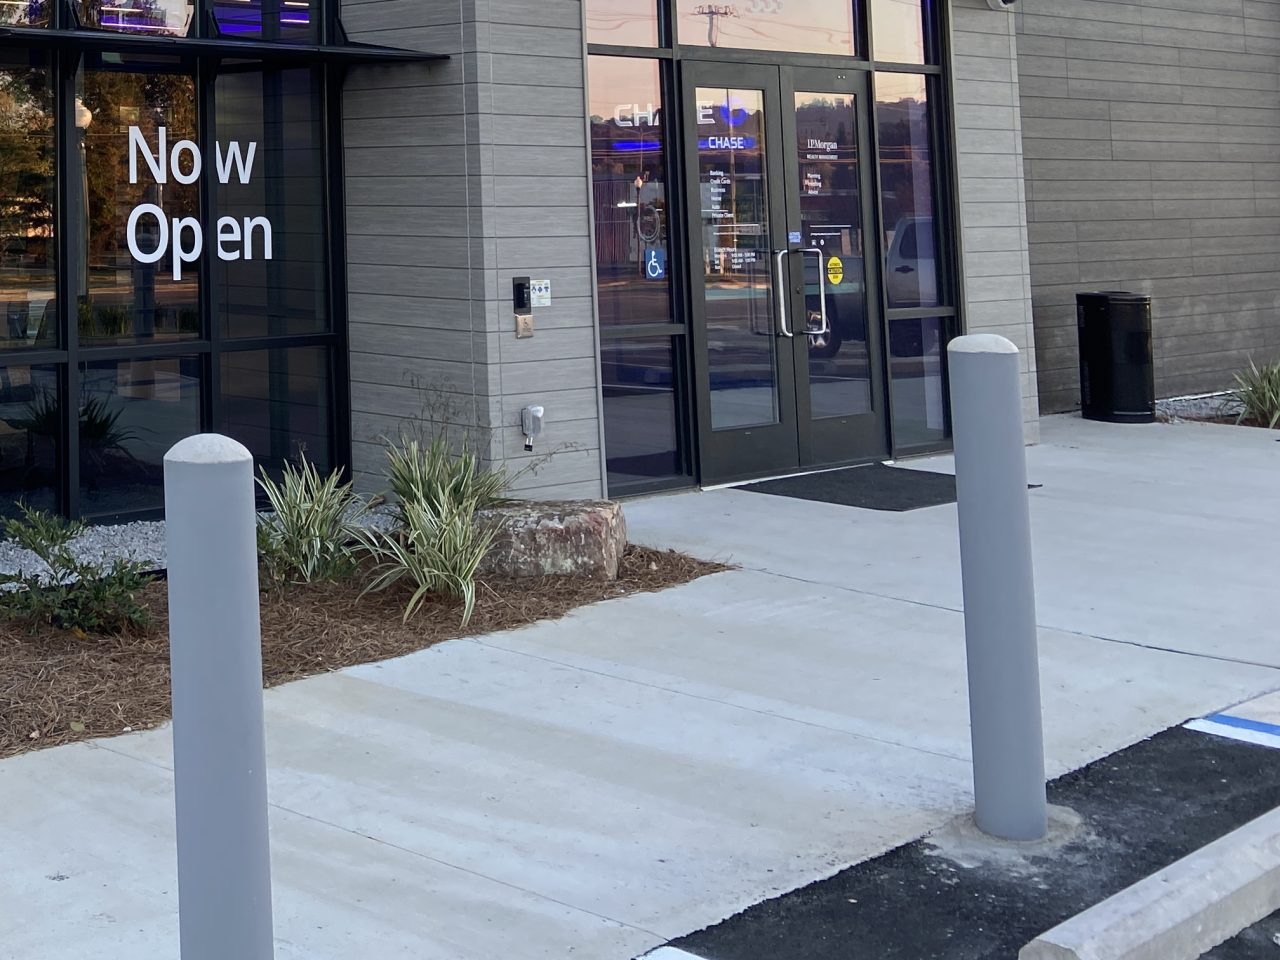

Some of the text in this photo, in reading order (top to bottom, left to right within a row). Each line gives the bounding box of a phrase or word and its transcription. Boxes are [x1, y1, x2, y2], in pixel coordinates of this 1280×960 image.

[613, 100, 716, 127] CHE
[128, 125, 257, 185] Now
[708, 136, 745, 149] CHASE
[126, 203, 273, 281] Open
